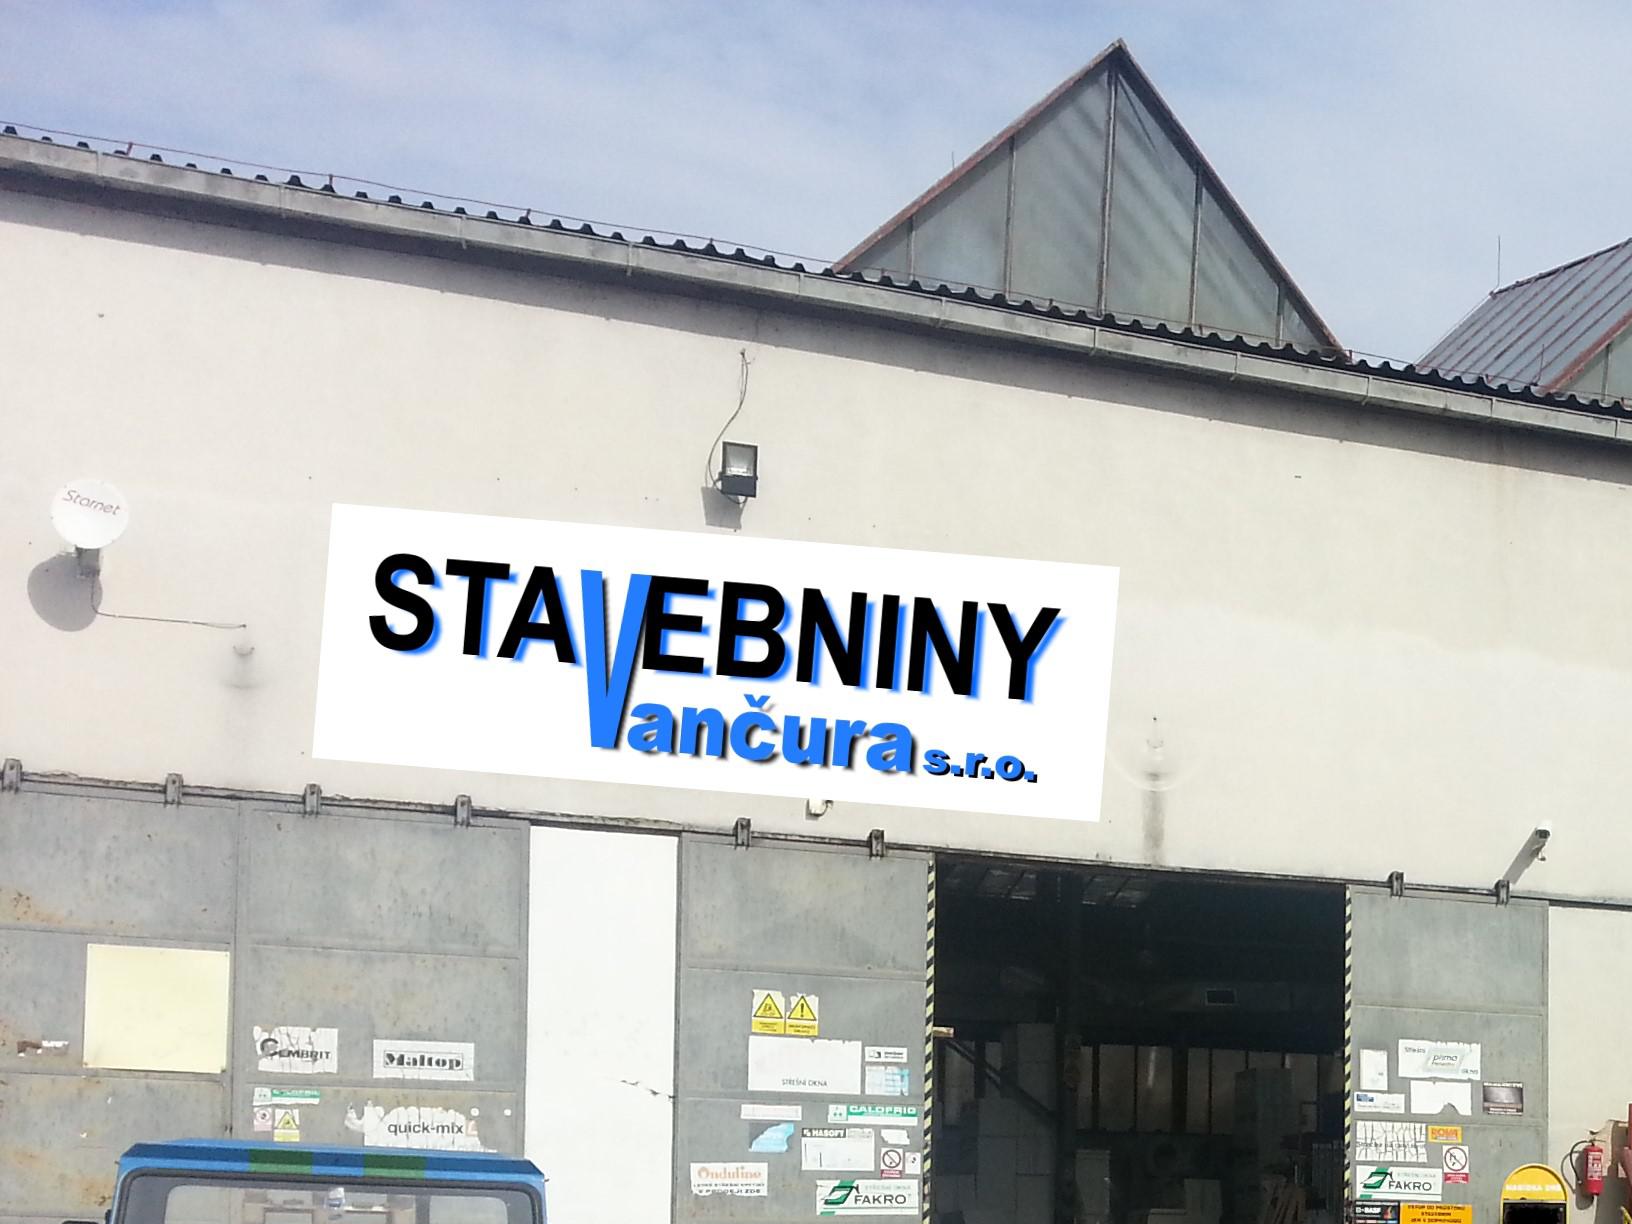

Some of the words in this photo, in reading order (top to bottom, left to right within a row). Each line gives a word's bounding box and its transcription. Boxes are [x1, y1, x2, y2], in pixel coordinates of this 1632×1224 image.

[368, 552, 1066, 704] STAVEBNINY
[922, 743, 1039, 784] s.r.o.
[384, 1052, 463, 1071] Maltop
[388, 1120, 464, 1136] quick-mix
[1388, 1180, 1433, 1192] FAKRO
[854, 1194, 907, 1205] FAKRO
